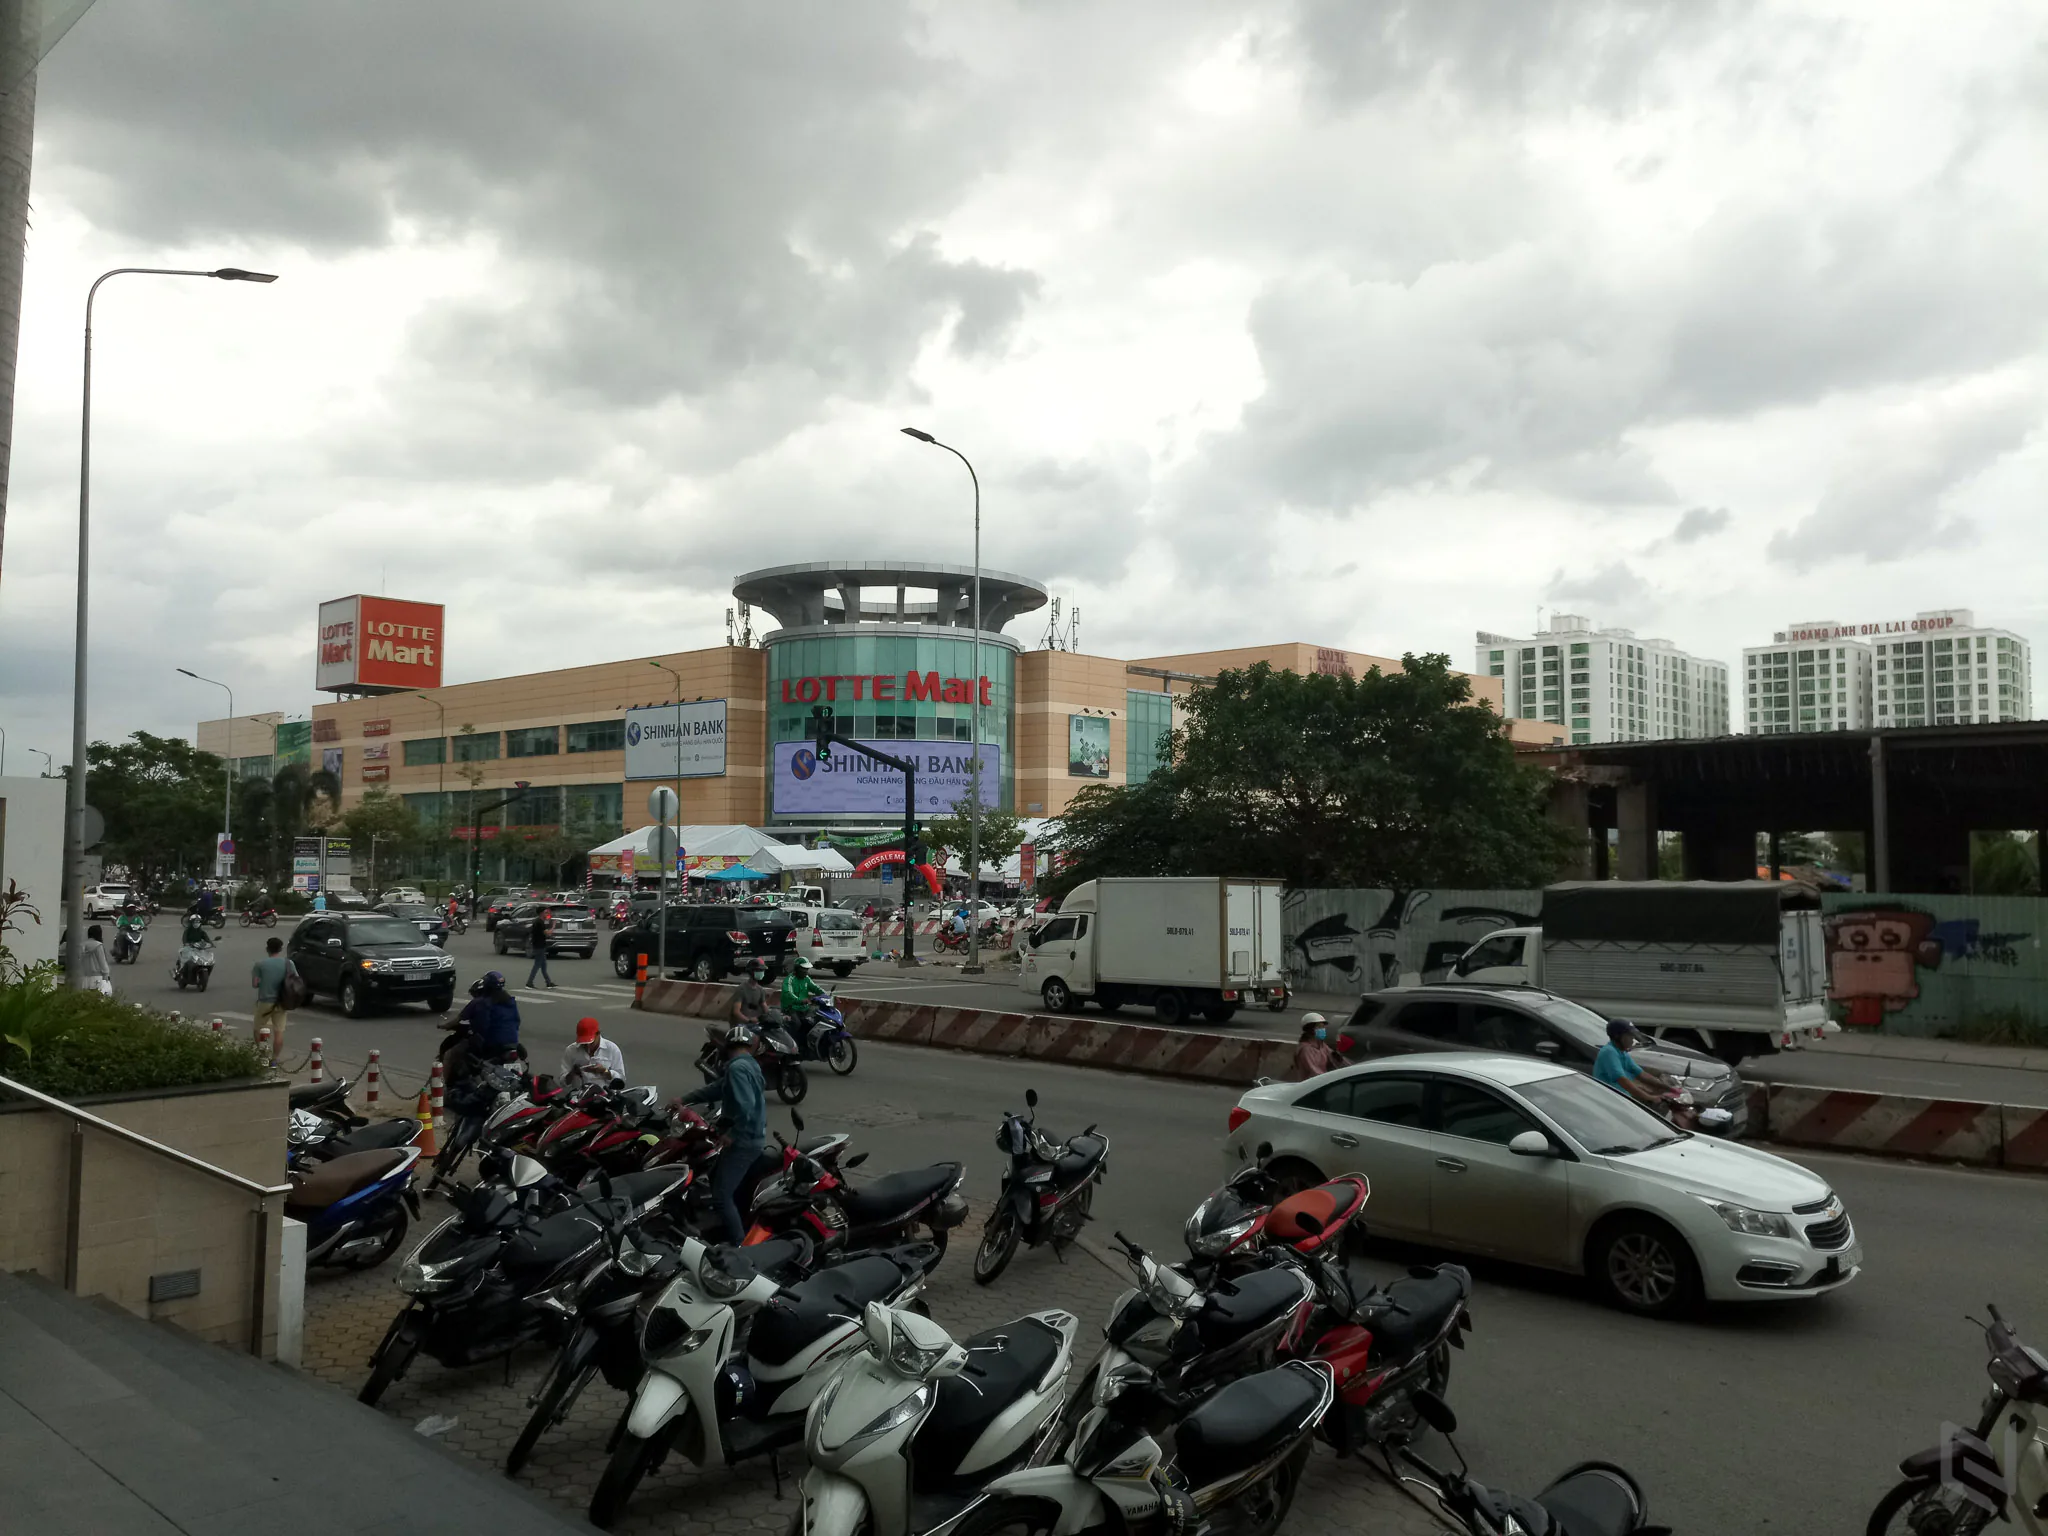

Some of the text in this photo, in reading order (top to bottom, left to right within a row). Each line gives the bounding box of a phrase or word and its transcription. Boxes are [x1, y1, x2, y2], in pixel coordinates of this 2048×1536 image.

[322, 621, 354, 640] LOTTE
[367, 621, 435, 642] LOTTE
[1834, 626, 1856, 638] ANH
[1861, 623, 1881, 635] GIA
[1886, 621, 1905, 633] LAI
[1911, 617, 1954, 631] GROUP
[321, 639, 353, 665] Mart
[367, 639, 434, 667] Mart
[781, 670, 992, 706] LOTTE Mart
[643, 719, 724, 740] SHINHAN BANK
[1126, 1501, 1160, 1516] YAMAHA
